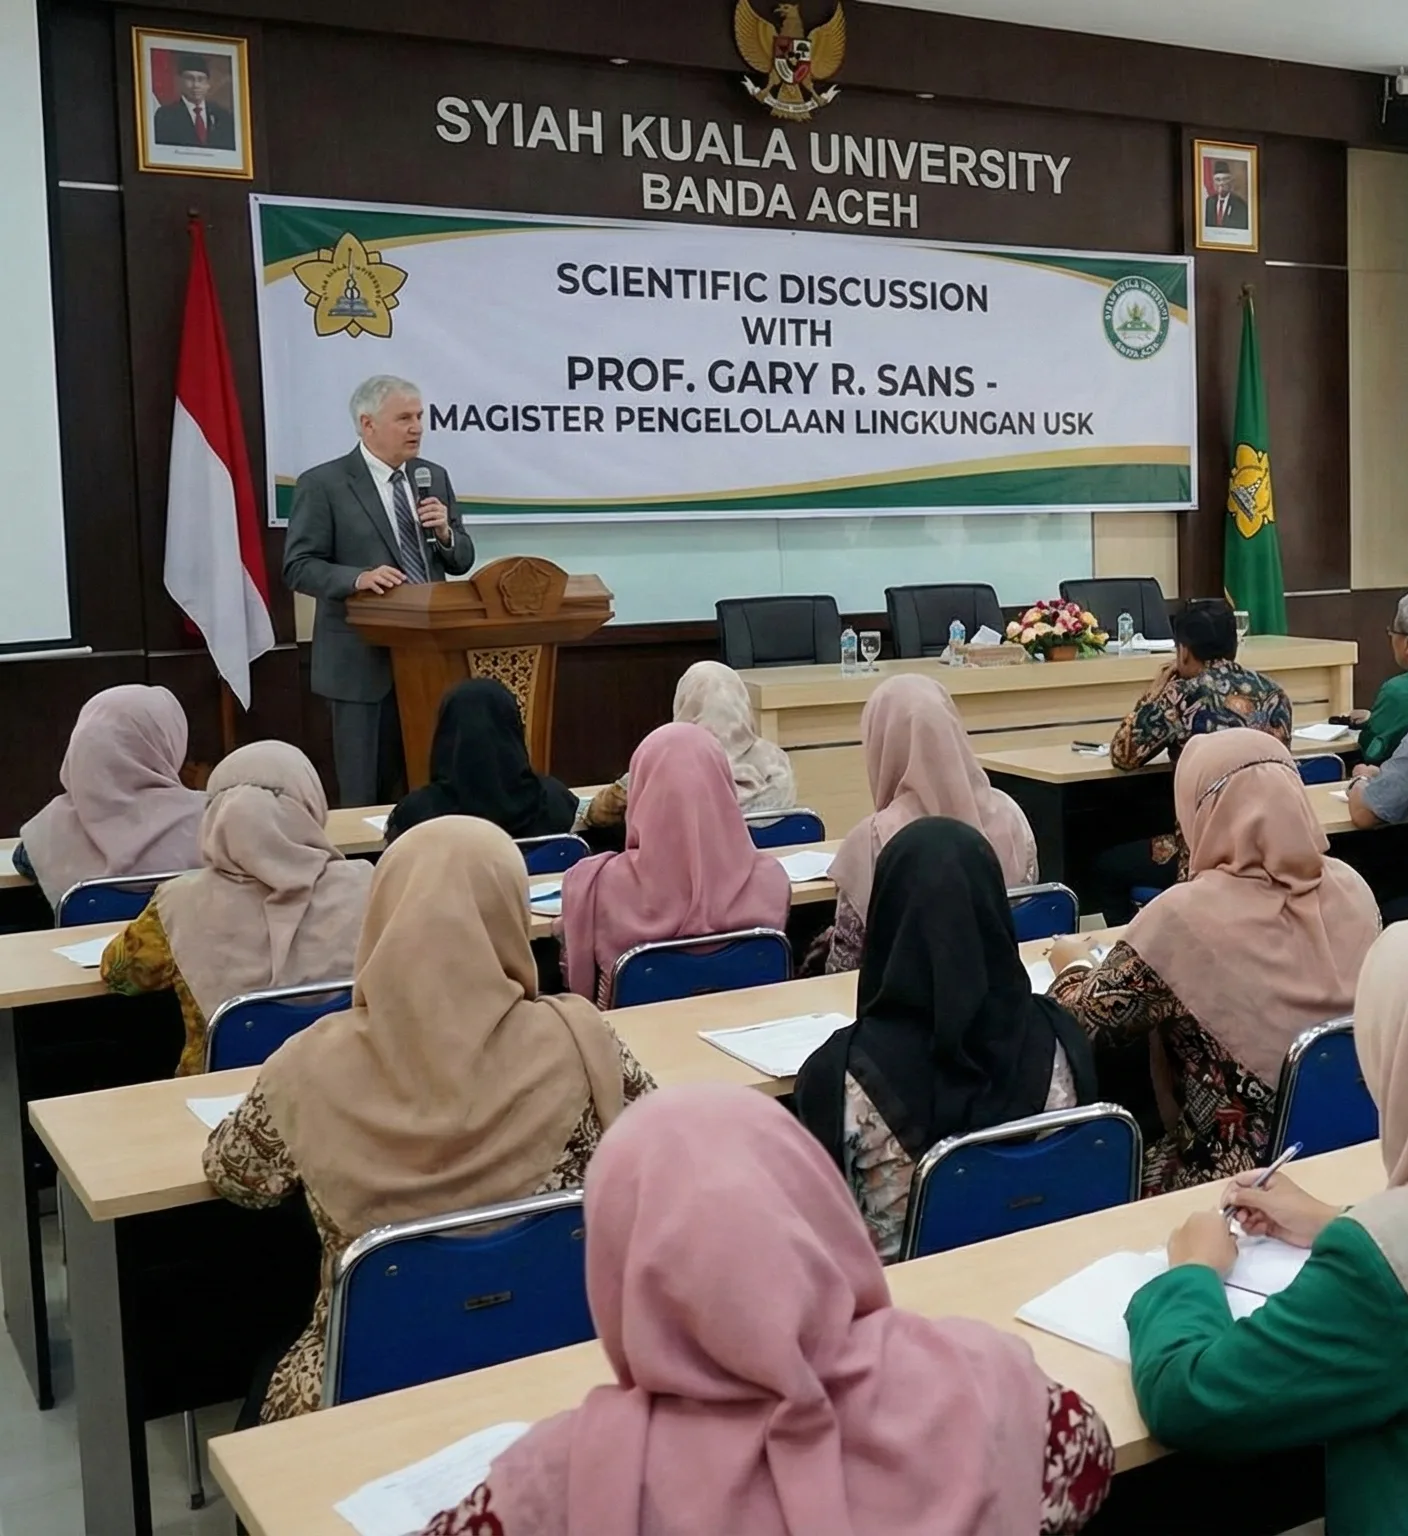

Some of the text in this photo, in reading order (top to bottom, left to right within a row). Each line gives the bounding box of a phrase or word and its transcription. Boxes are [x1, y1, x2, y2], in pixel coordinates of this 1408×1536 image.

[436, 96, 1071, 194] SYIAH KUALA UNIVERSITY
[642, 172, 918, 229] BANDA ACEH
[556, 262, 988, 313] SCIENTIFIC DISCUSSION
[741, 316, 832, 347] WITH
[567, 355, 695, 393] PROF.
[707, 359, 819, 395] GARY
[831, 362, 866, 396] R.
[877, 363, 975, 398] SANS
[429, 403, 1094, 435] MAGISTER PENGELOLAAN LINGKUNGAN USK
